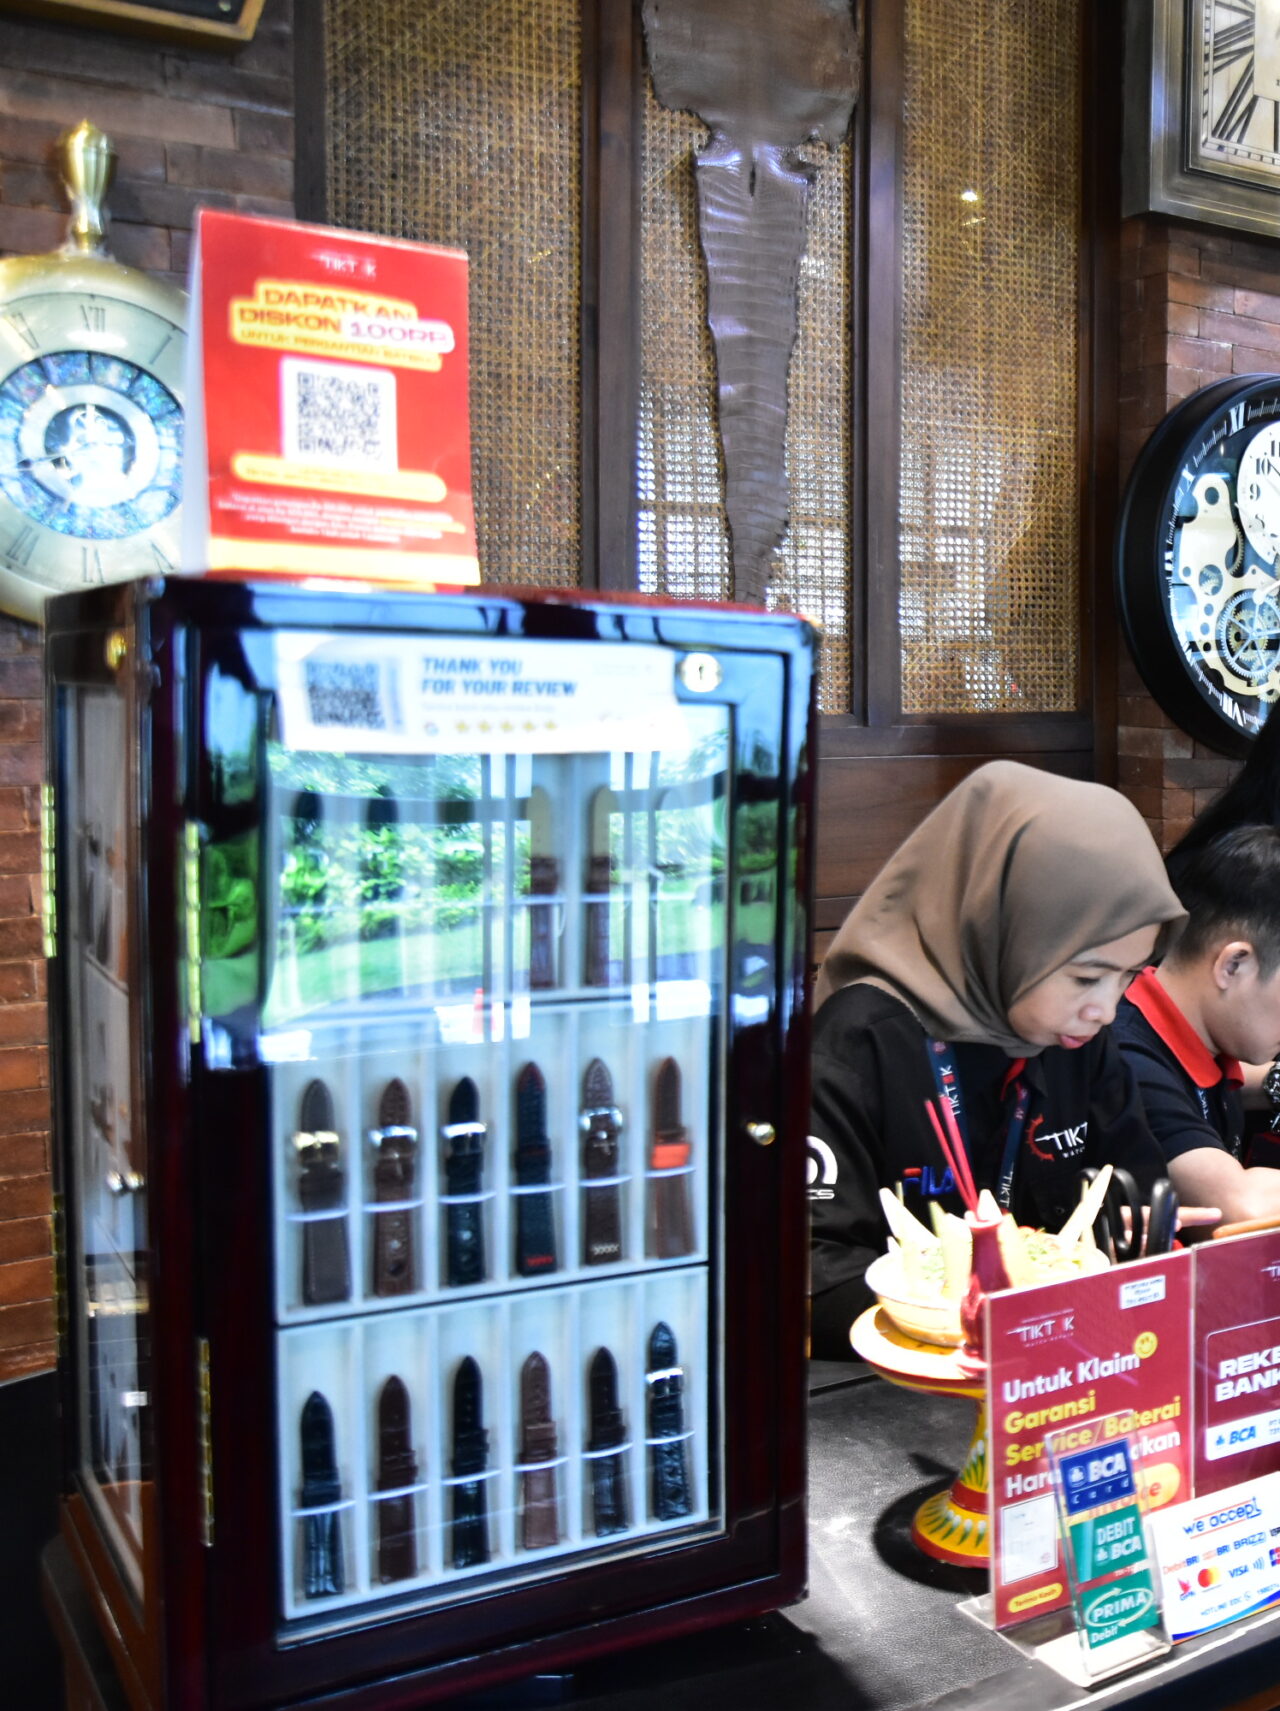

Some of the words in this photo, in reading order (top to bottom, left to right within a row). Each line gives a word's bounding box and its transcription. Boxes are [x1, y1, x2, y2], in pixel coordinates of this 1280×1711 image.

[265, 288, 412, 322] DAPATKAN
[239, 308, 341, 333] DISKON
[422, 656, 482, 675] THANK
[487, 656, 523, 675] YOU
[421, 679, 456, 696] FOR
[461, 679, 507, 696] YOUR
[511, 680, 578, 697] REVIEW
[903, 1166, 955, 1196] FILA
[1004, 1368, 1073, 1403] Untuk
[1077, 1352, 1140, 1384] Klaim
[1005, 1389, 1096, 1434] Garansi
[1229, 1426, 1256, 1445] BCA
[1006, 1465, 1061, 1498] Hara
[1089, 1452, 1127, 1482] BCA
[1183, 1519, 1204, 1534] we
[1209, 1497, 1262, 1528] accept
[1095, 1516, 1136, 1546] DEBIT
[1110, 1535, 1143, 1561] BCA
[1228, 1565, 1249, 1578] VISA
[1092, 1590, 1149, 1623] PRIMA
[1090, 1623, 1118, 1644] Debit
